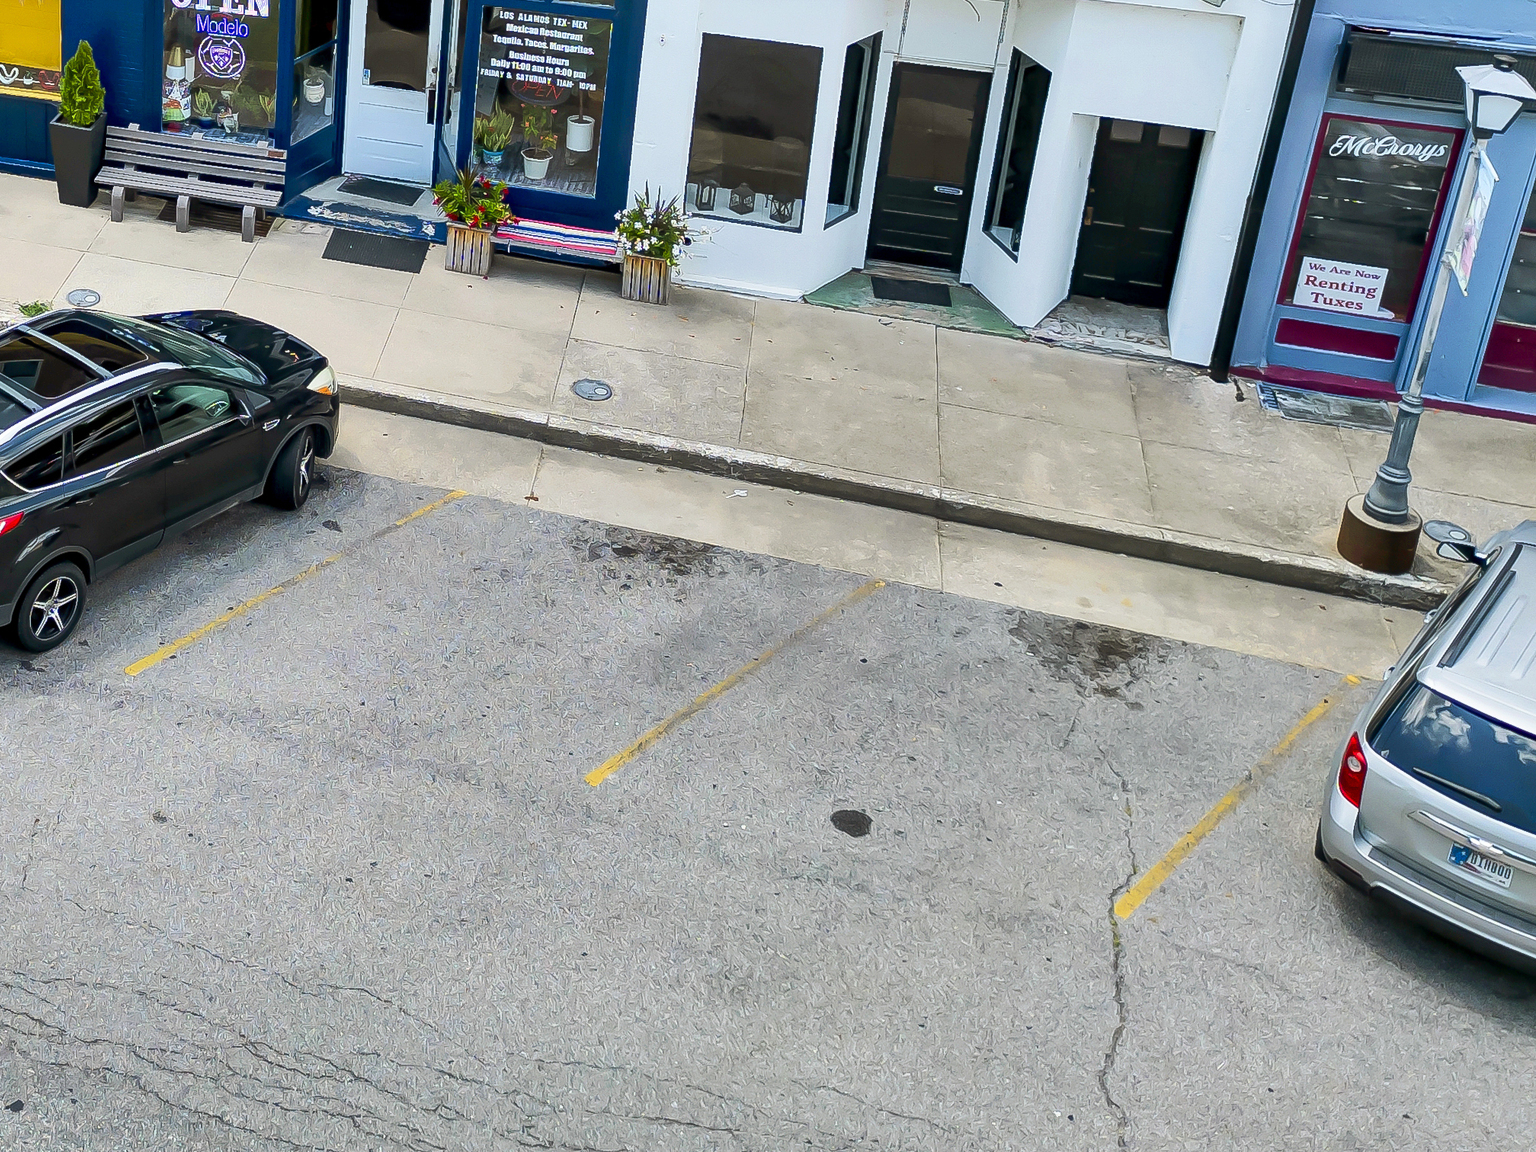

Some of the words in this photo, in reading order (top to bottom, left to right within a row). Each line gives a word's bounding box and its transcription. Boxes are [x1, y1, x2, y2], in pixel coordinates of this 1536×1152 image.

[196, 14, 249, 37] Modelo
[500, 11, 514, 20] LOS
[518, 13, 550, 24] ALAMOS
[506, 23, 539, 35] Mexican
[540, 28, 583, 42] Restaurant
[491, 58, 510, 69] Daily
[512, 62, 531, 71] 11:00
[532, 65, 544, 73] am
[573, 70, 586, 79] pm
[509, 51, 545, 63] Business
[546, 56, 570, 66] Hours
[480, 68, 504, 78] FRIDAY
[516, 73, 552, 84] SATURDAY
[579, 82, 596, 91] 10PM
[1330, 135, 1448, 162] McCrorys
[1309, 263, 1326, 272] We
[1329, 266, 1351, 275] Are
[1355, 270, 1381, 280] Now
[1305, 275, 1378, 299] Renting
[1311, 292, 1363, 310] Tuxes
